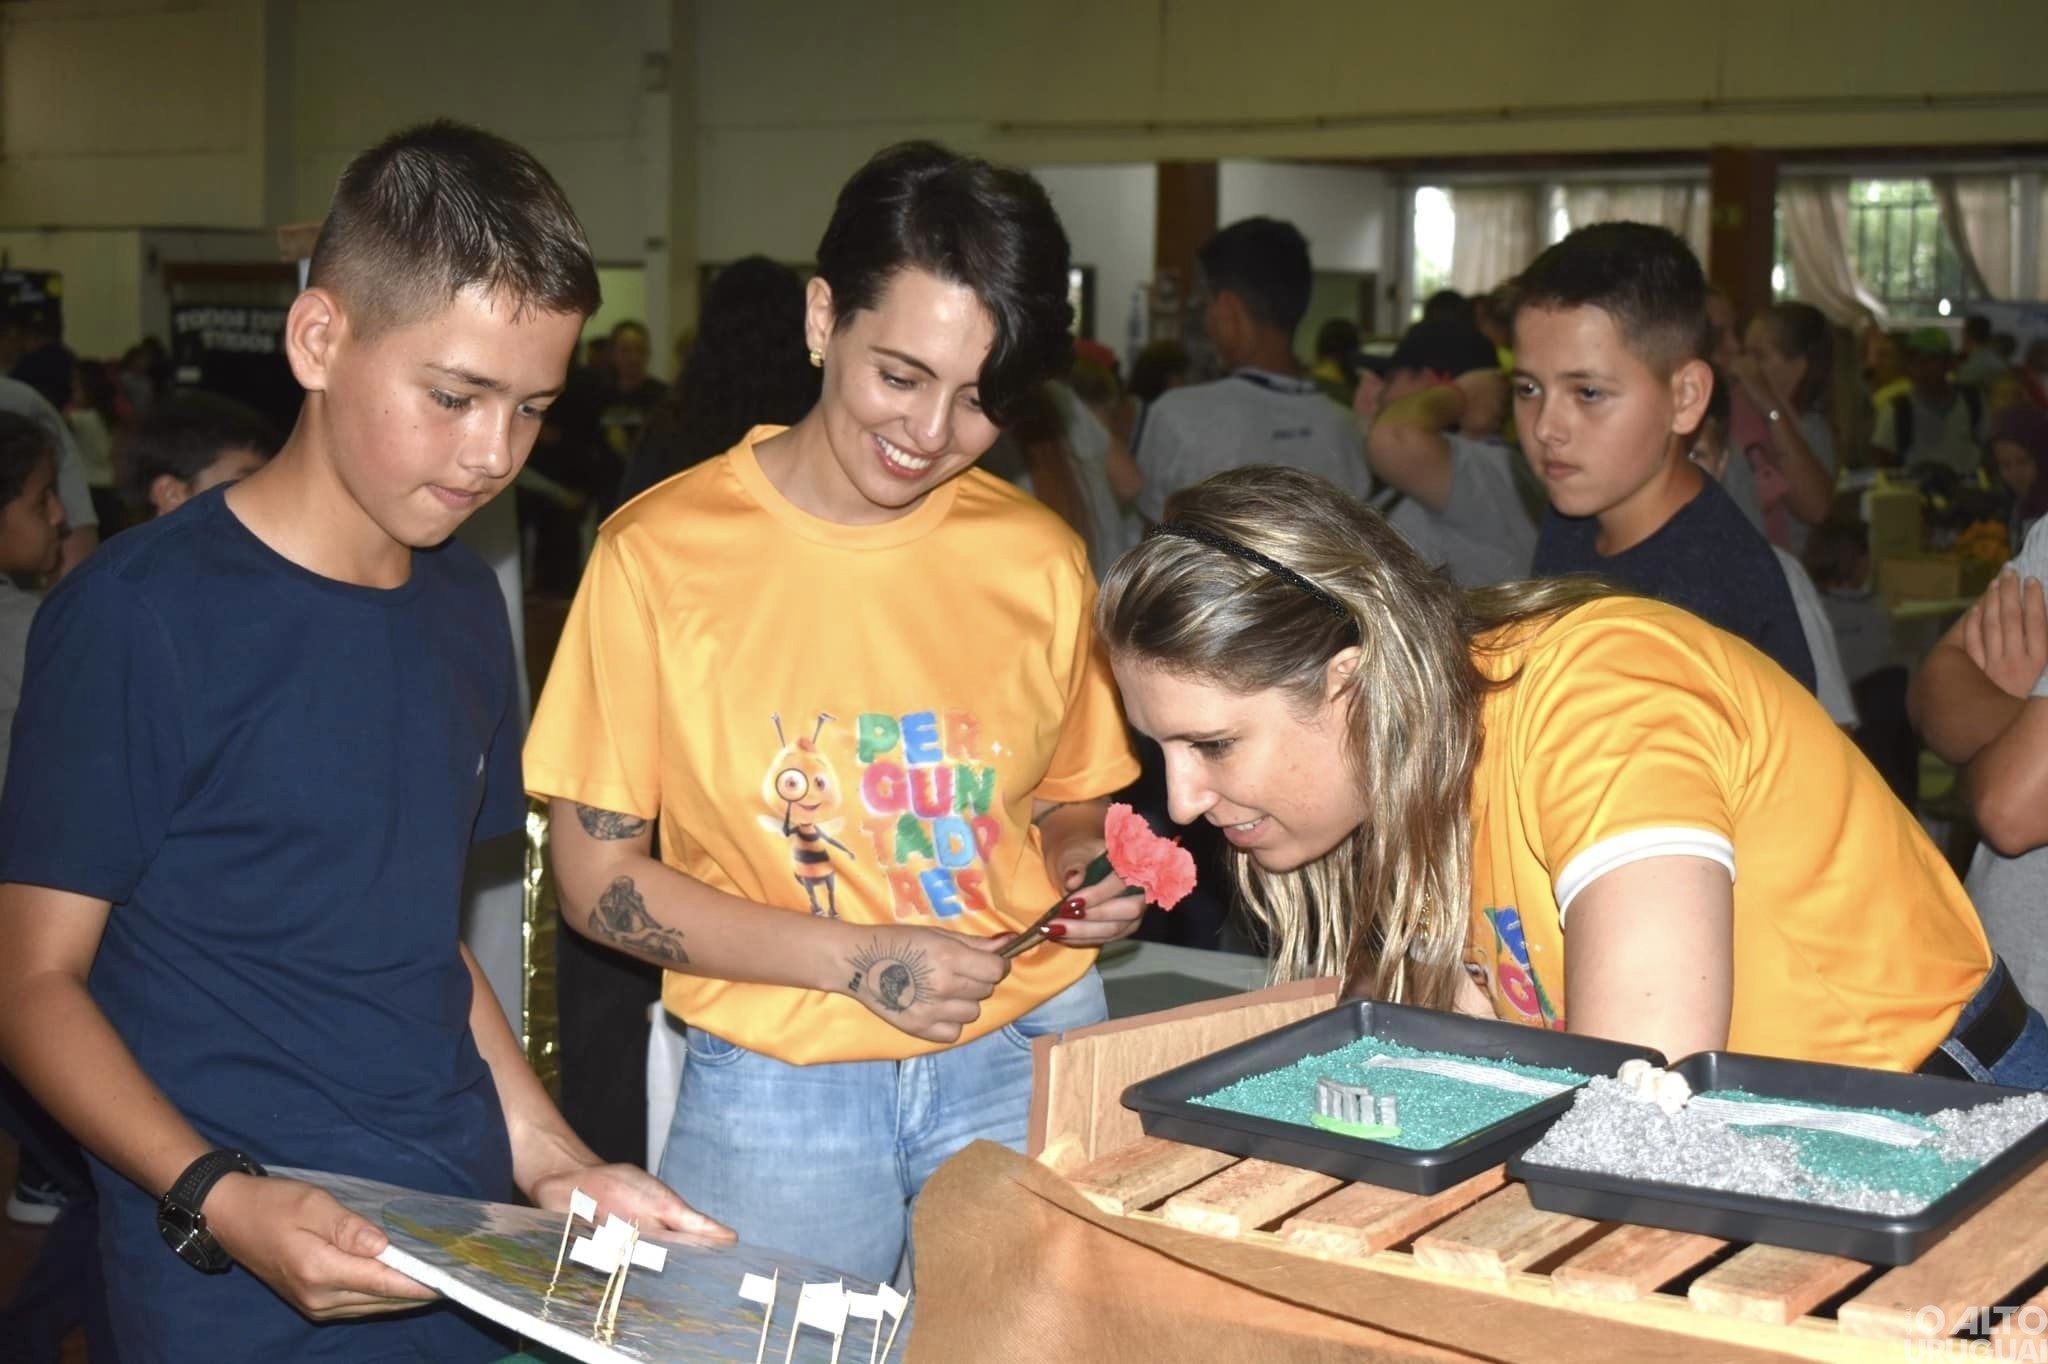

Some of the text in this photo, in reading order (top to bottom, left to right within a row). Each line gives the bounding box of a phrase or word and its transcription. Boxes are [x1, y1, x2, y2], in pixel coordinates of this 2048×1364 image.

[857, 711, 981, 764] PER
[862, 762, 996, 817] GUN
[889, 867, 987, 918] RES
